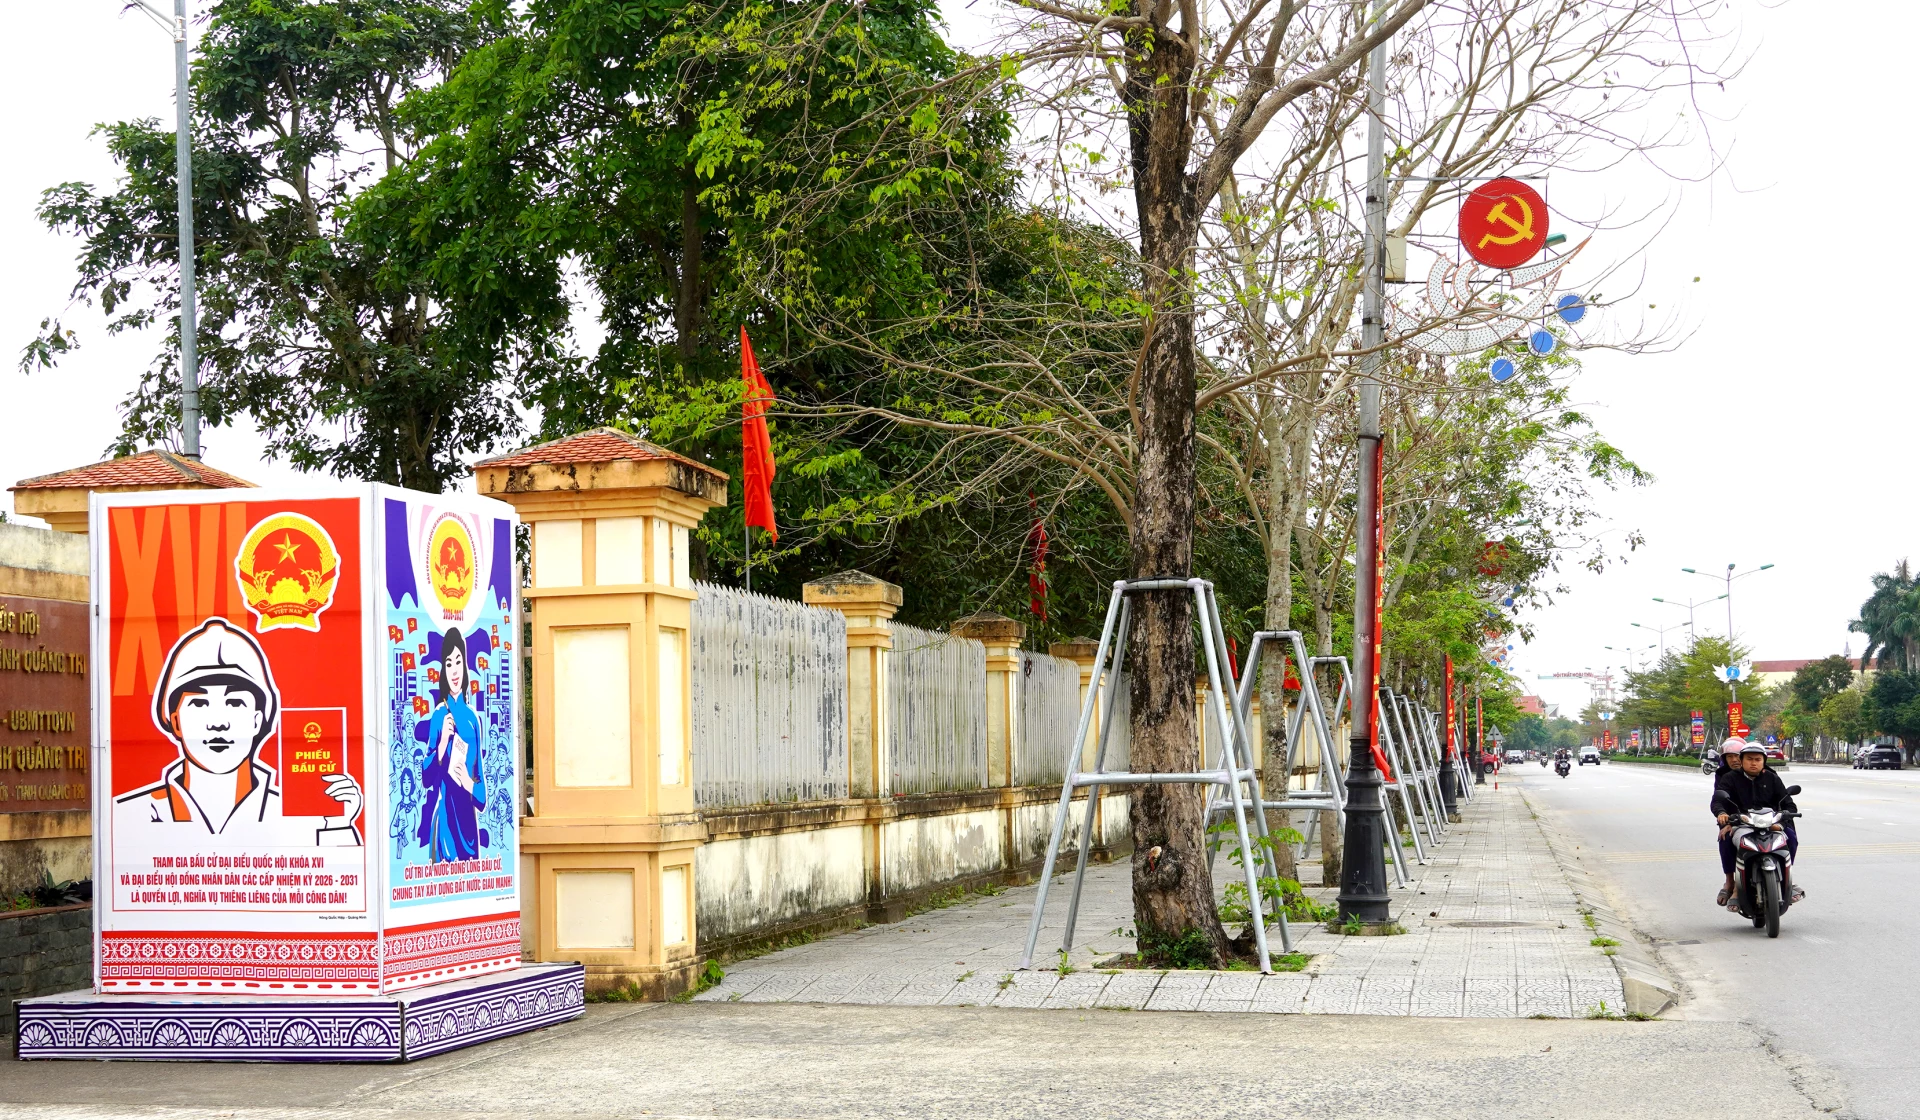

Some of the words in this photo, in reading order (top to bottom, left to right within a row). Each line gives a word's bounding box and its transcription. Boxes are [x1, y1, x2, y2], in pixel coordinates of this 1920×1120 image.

[20, 609, 40, 638] HỘI
[24, 643, 65, 673] QUẢNG
[69, 652, 87, 678] TRỊ
[11, 710, 75, 733] UBMTTQVN
[16, 738, 63, 772] QUẢNG
[67, 746, 87, 773] TRỊ
[296, 748, 330, 759] PHIẾU
[292, 762, 315, 772] BẦU
[319, 761, 336, 772] CỬ
[38, 780, 71, 800] QUẢNG
[153, 857, 173, 868] THAM
[175, 857, 188, 868] GIA
[190, 853, 205, 868] BẦU
[207, 852, 218, 868] CỬ
[219, 857, 231, 870] ĐẠI
[233, 852, 250, 868] BIỂU
[253, 853, 273, 869] QUỐC
[275, 855, 287, 871] HỘI
[290, 855, 309, 868] KHÓA
[311, 857, 324, 868] XVI
[405, 862, 414, 880] CỬ
[414, 866, 423, 878] TRI
[425, 859, 433, 877] CẢ
[433, 859, 449, 876] NƯỚC
[450, 858, 465, 875] ĐỒNG
[467, 857, 480, 874] LÒNG
[482, 856, 492, 872] BẦU
[493, 854, 502, 871] CỬ,
[120, 872, 130, 885] VÀ
[132, 874, 144, 888] ĐẠI
[146, 870, 163, 885] BIỂU
[165, 872, 177, 888] HỘI
[179, 870, 200, 885] ĐỒNG
[202, 872, 222, 885] NHÂN
[224, 872, 240, 885] DÂN
[242, 872, 257, 886] CÁC
[259, 871, 274, 886] CẤP
[276, 873, 300, 888] NHIỆM
[303, 873, 313, 886] KỲ
[315, 875, 333, 886] 2026
[340, 875, 358, 886] 2031
[392, 887, 412, 901] CHUNG
[414, 885, 424, 898] TAY
[426, 882, 437, 896] XÂY
[438, 882, 453, 898] DỰNG
[455, 877, 466, 893] ĐẤT
[467, 876, 481, 892] NƯỚC
[482, 876, 494, 890] GIÀU
[495, 875, 513, 891] MẠNH!
[131, 889, 140, 902] LÀ
[142, 888, 166, 904] QUYỀN
[168, 891, 181, 905] LỢI,
[184, 889, 206, 902] NGHĨA
[208, 892, 218, 905] VỤ
[220, 889, 246, 903] THIÊNG
[248, 889, 270, 903] LIÊNG
[272, 888, 287, 903] CỦA
[289, 888, 304, 903] MỖI
[306, 890, 326, 903] CÔNG
[328, 890, 347, 903] DÂN!
